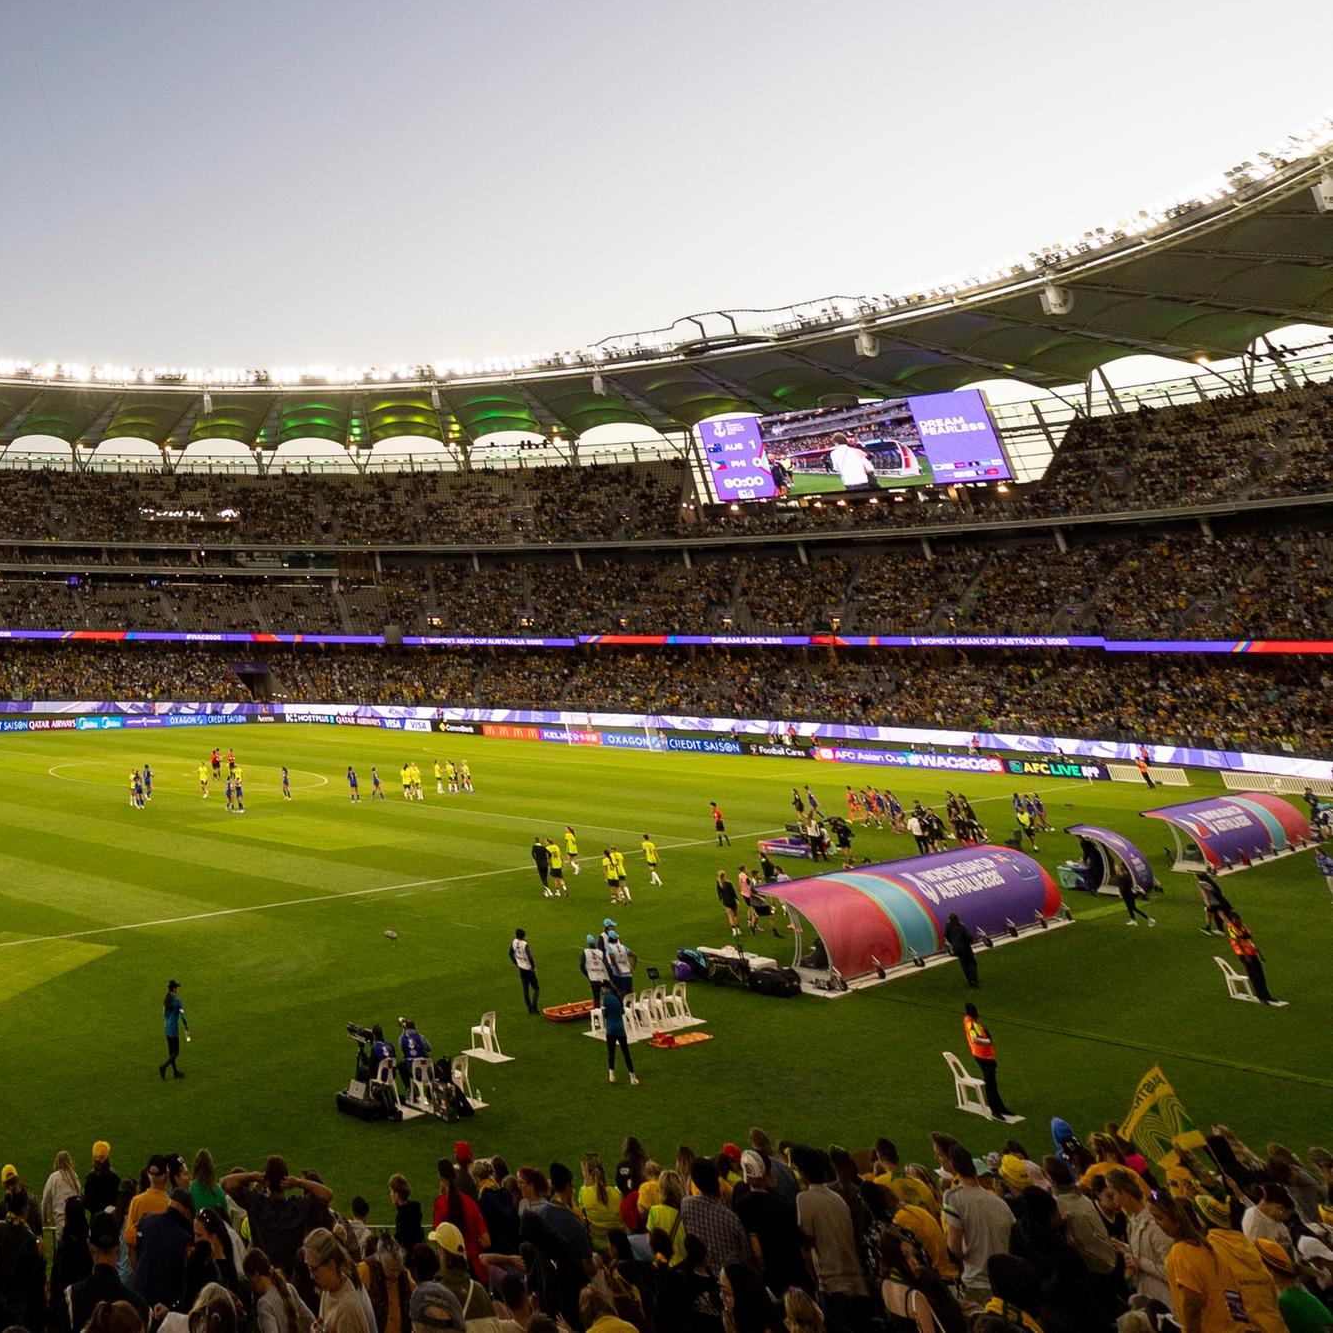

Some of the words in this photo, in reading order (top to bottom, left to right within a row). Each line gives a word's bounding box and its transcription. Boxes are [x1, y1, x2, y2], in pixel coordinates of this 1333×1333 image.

[919, 416, 964, 427] DREAM
[724, 442, 744, 452] AUS
[28, 720, 50, 730] QATAR
[385, 719, 402, 729] VISA
[410, 720, 427, 730] VISA
[669, 738, 702, 750] CREDIT
[705, 740, 740, 752] SAISON
[835, 750, 856, 760] AFC
[858, 751, 884, 762] Asian
[885, 753, 907, 765] Cup
[1024, 762, 1050, 775] AFC
[1050, 763, 1082, 777] LIVE
[935, 872, 986, 900] AUSTRALIA
